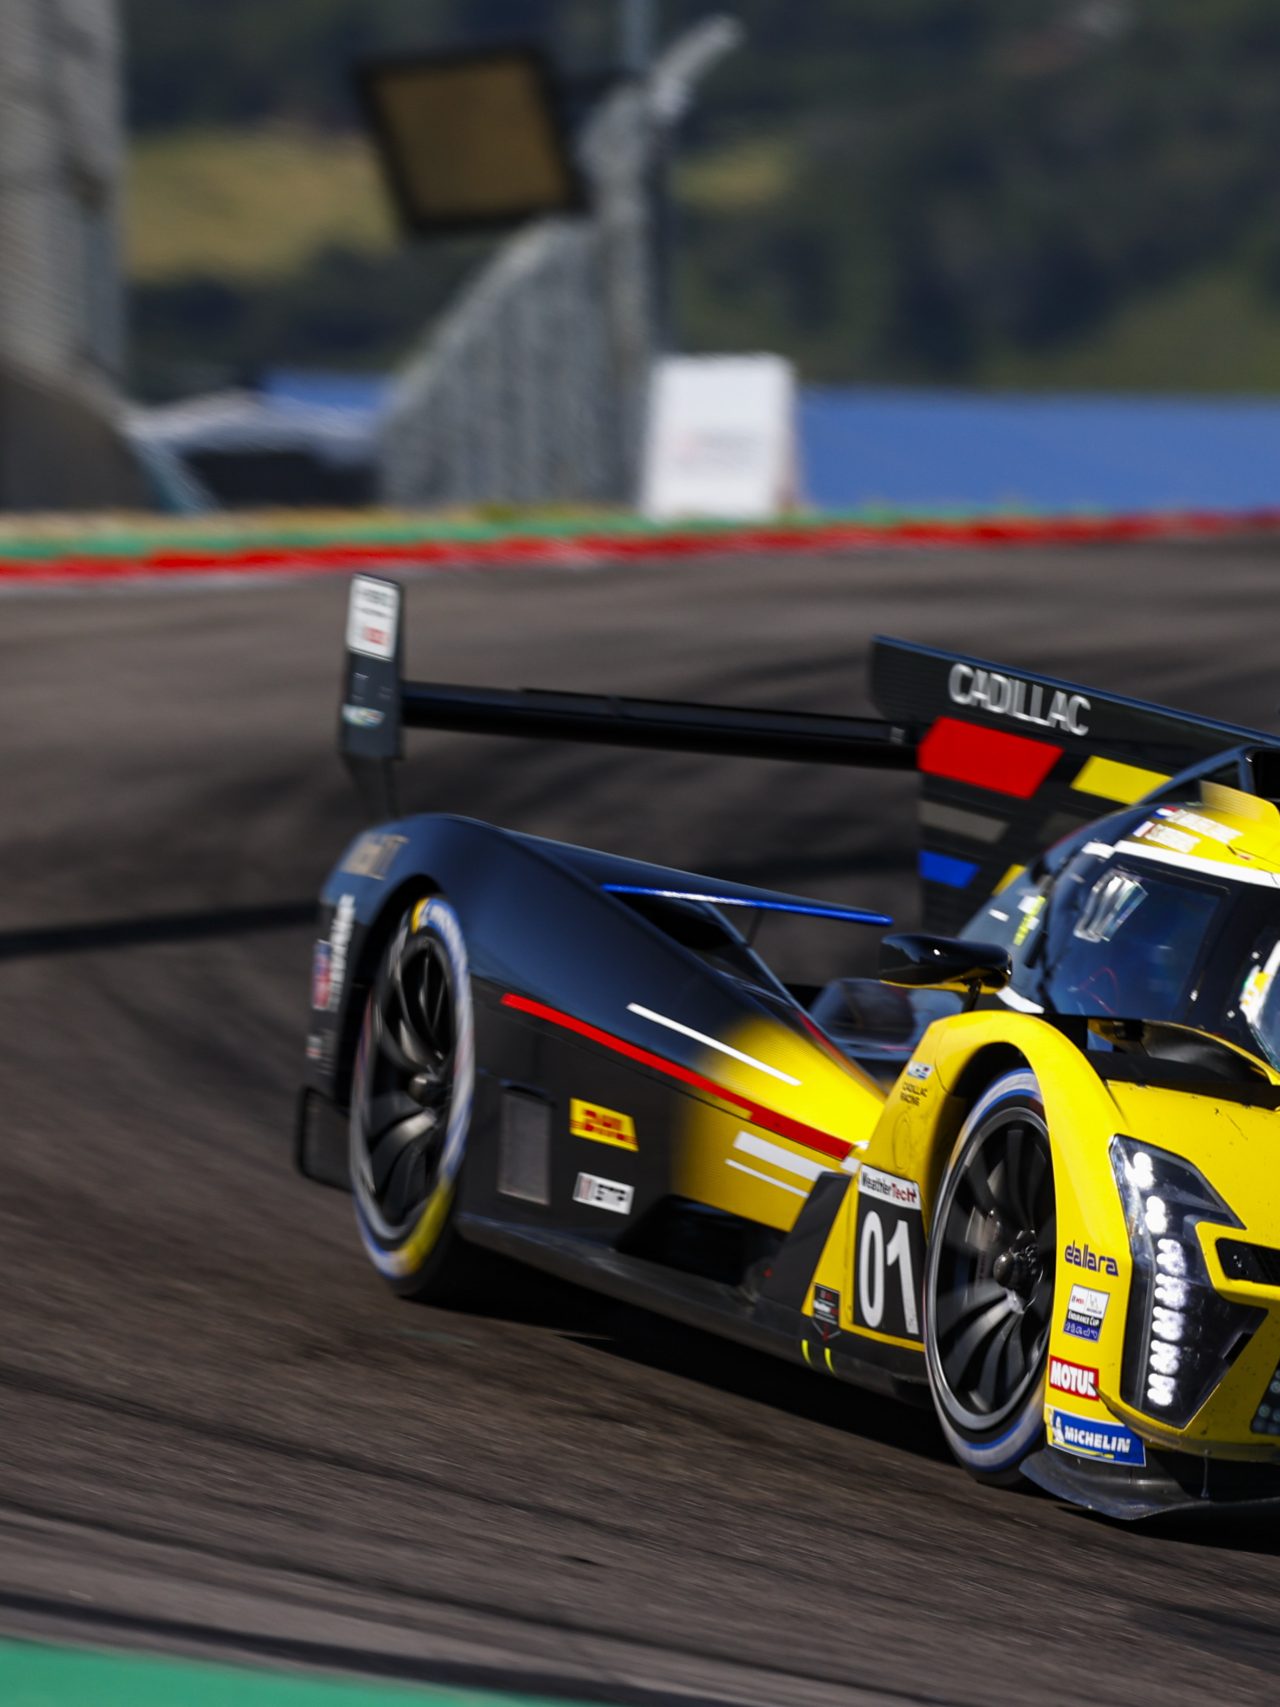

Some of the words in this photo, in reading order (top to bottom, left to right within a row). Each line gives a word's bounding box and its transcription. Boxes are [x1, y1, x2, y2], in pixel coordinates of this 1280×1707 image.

[949, 663, 1091, 736] CADILLAC
[862, 1171, 917, 1204] WeatherTech
[859, 1210, 919, 1335] 01
[1064, 1240, 1119, 1276] dallara
[1050, 1360, 1097, 1397] MOTUL
[1065, 1425, 1131, 1453] MICHELIN
